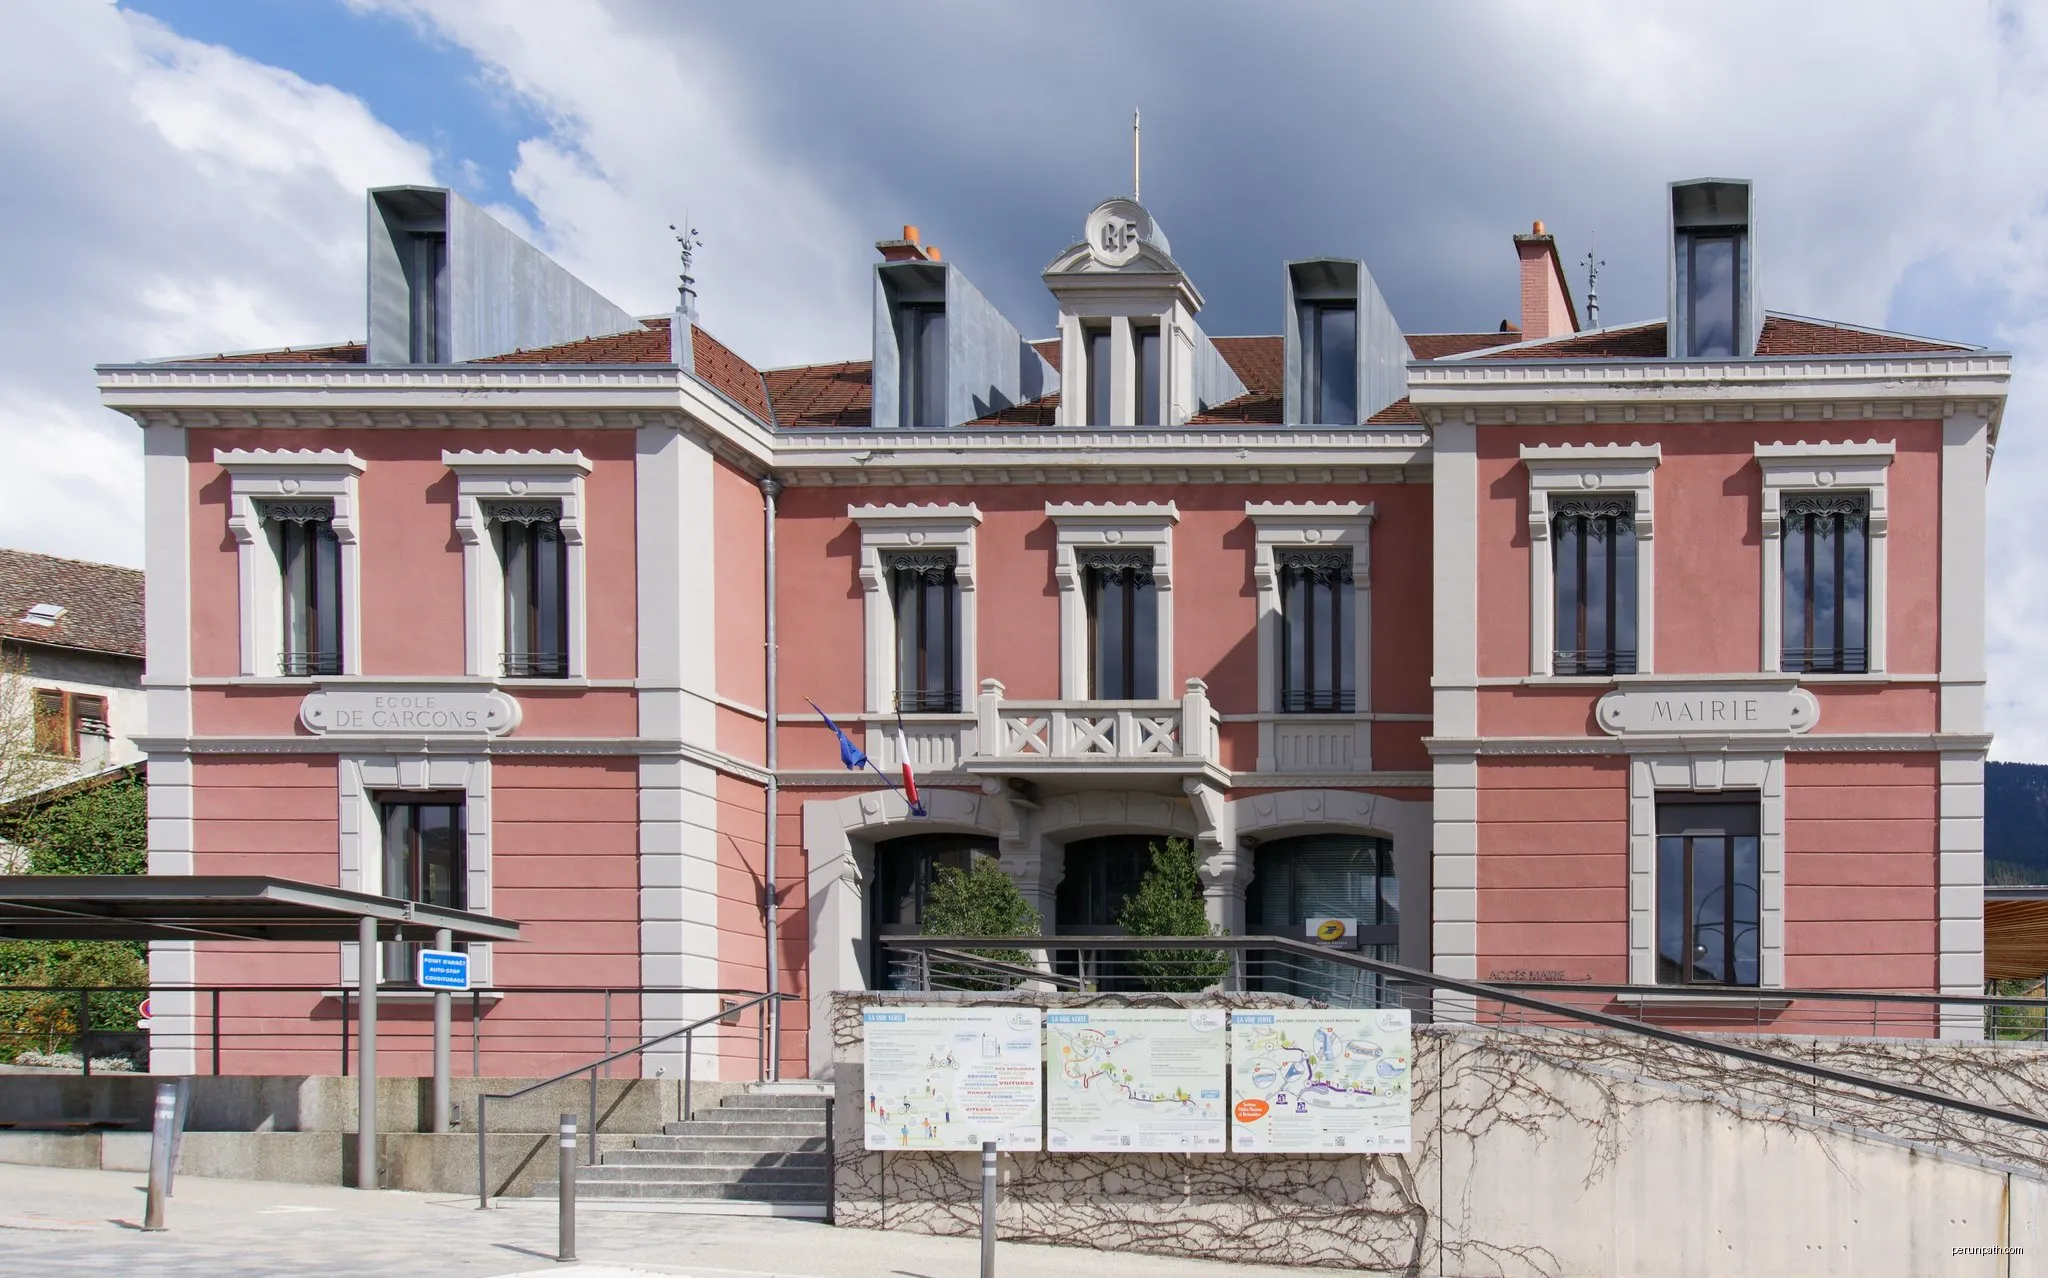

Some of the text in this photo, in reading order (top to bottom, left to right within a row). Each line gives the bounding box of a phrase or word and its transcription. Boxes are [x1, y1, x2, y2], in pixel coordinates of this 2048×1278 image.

[1101, 219, 1137, 252] RF
[375, 696, 436, 708] ECOLE
[1651, 699, 1758, 721] MAIRIE
[336, 710, 478, 727] DE GARCONS
[424, 975, 465, 983] COVOITURAGE
